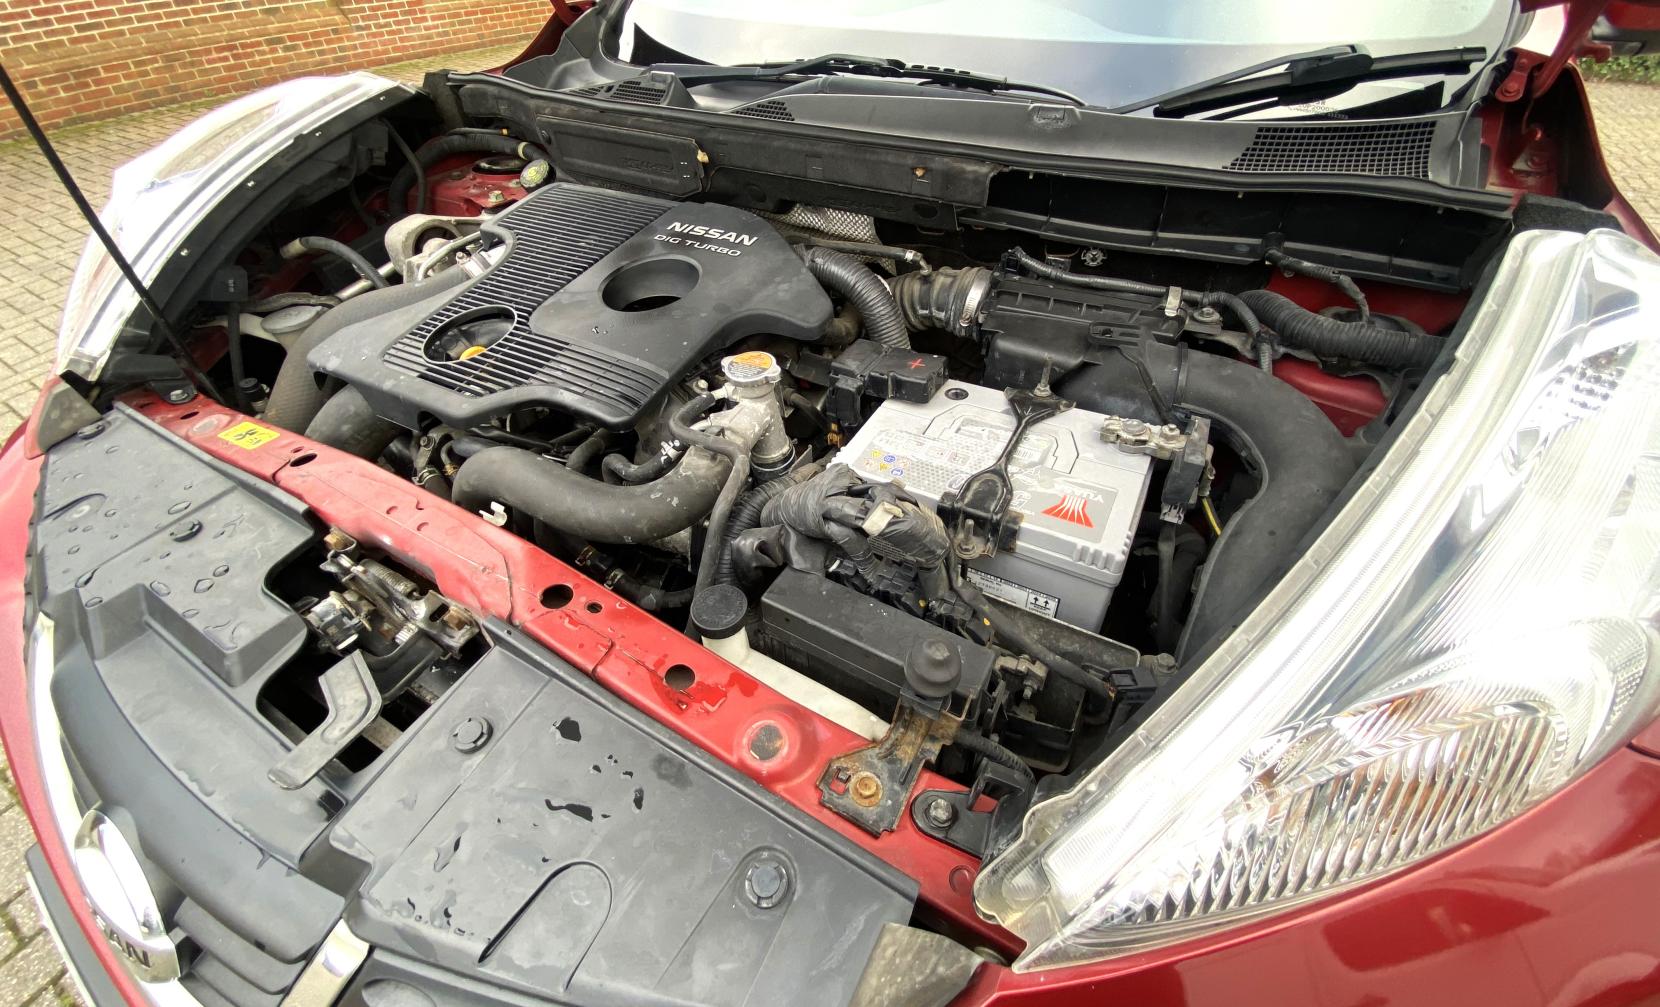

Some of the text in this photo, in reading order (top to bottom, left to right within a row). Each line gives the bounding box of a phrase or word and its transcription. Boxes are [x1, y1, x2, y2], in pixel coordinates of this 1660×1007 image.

[654, 234, 742, 256] DIG TURBO
[667, 222, 758, 246] NISSAN
